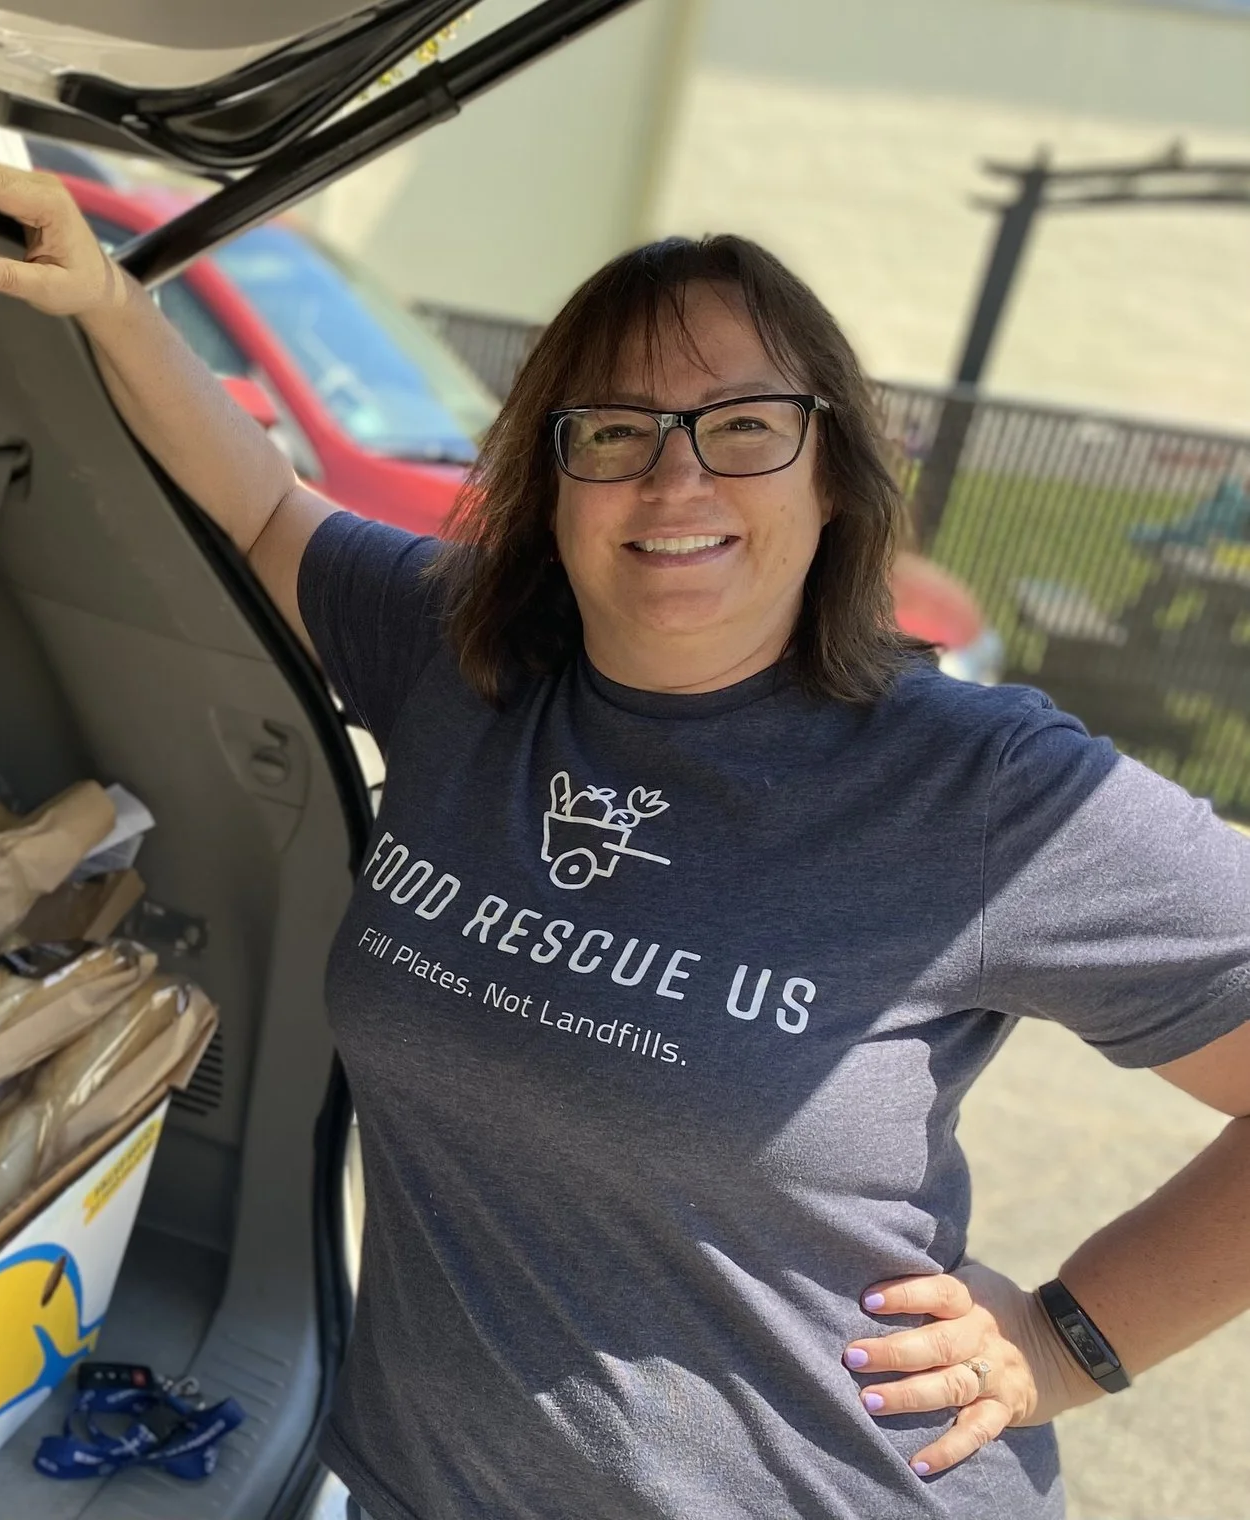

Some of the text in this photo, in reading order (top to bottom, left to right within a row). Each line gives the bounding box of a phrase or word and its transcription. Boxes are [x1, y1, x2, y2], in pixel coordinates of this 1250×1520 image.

[358, 927, 688, 1067] Fill Plates. Not Landfills.
[364, 831, 818, 1035] FOOD RESCUE US
